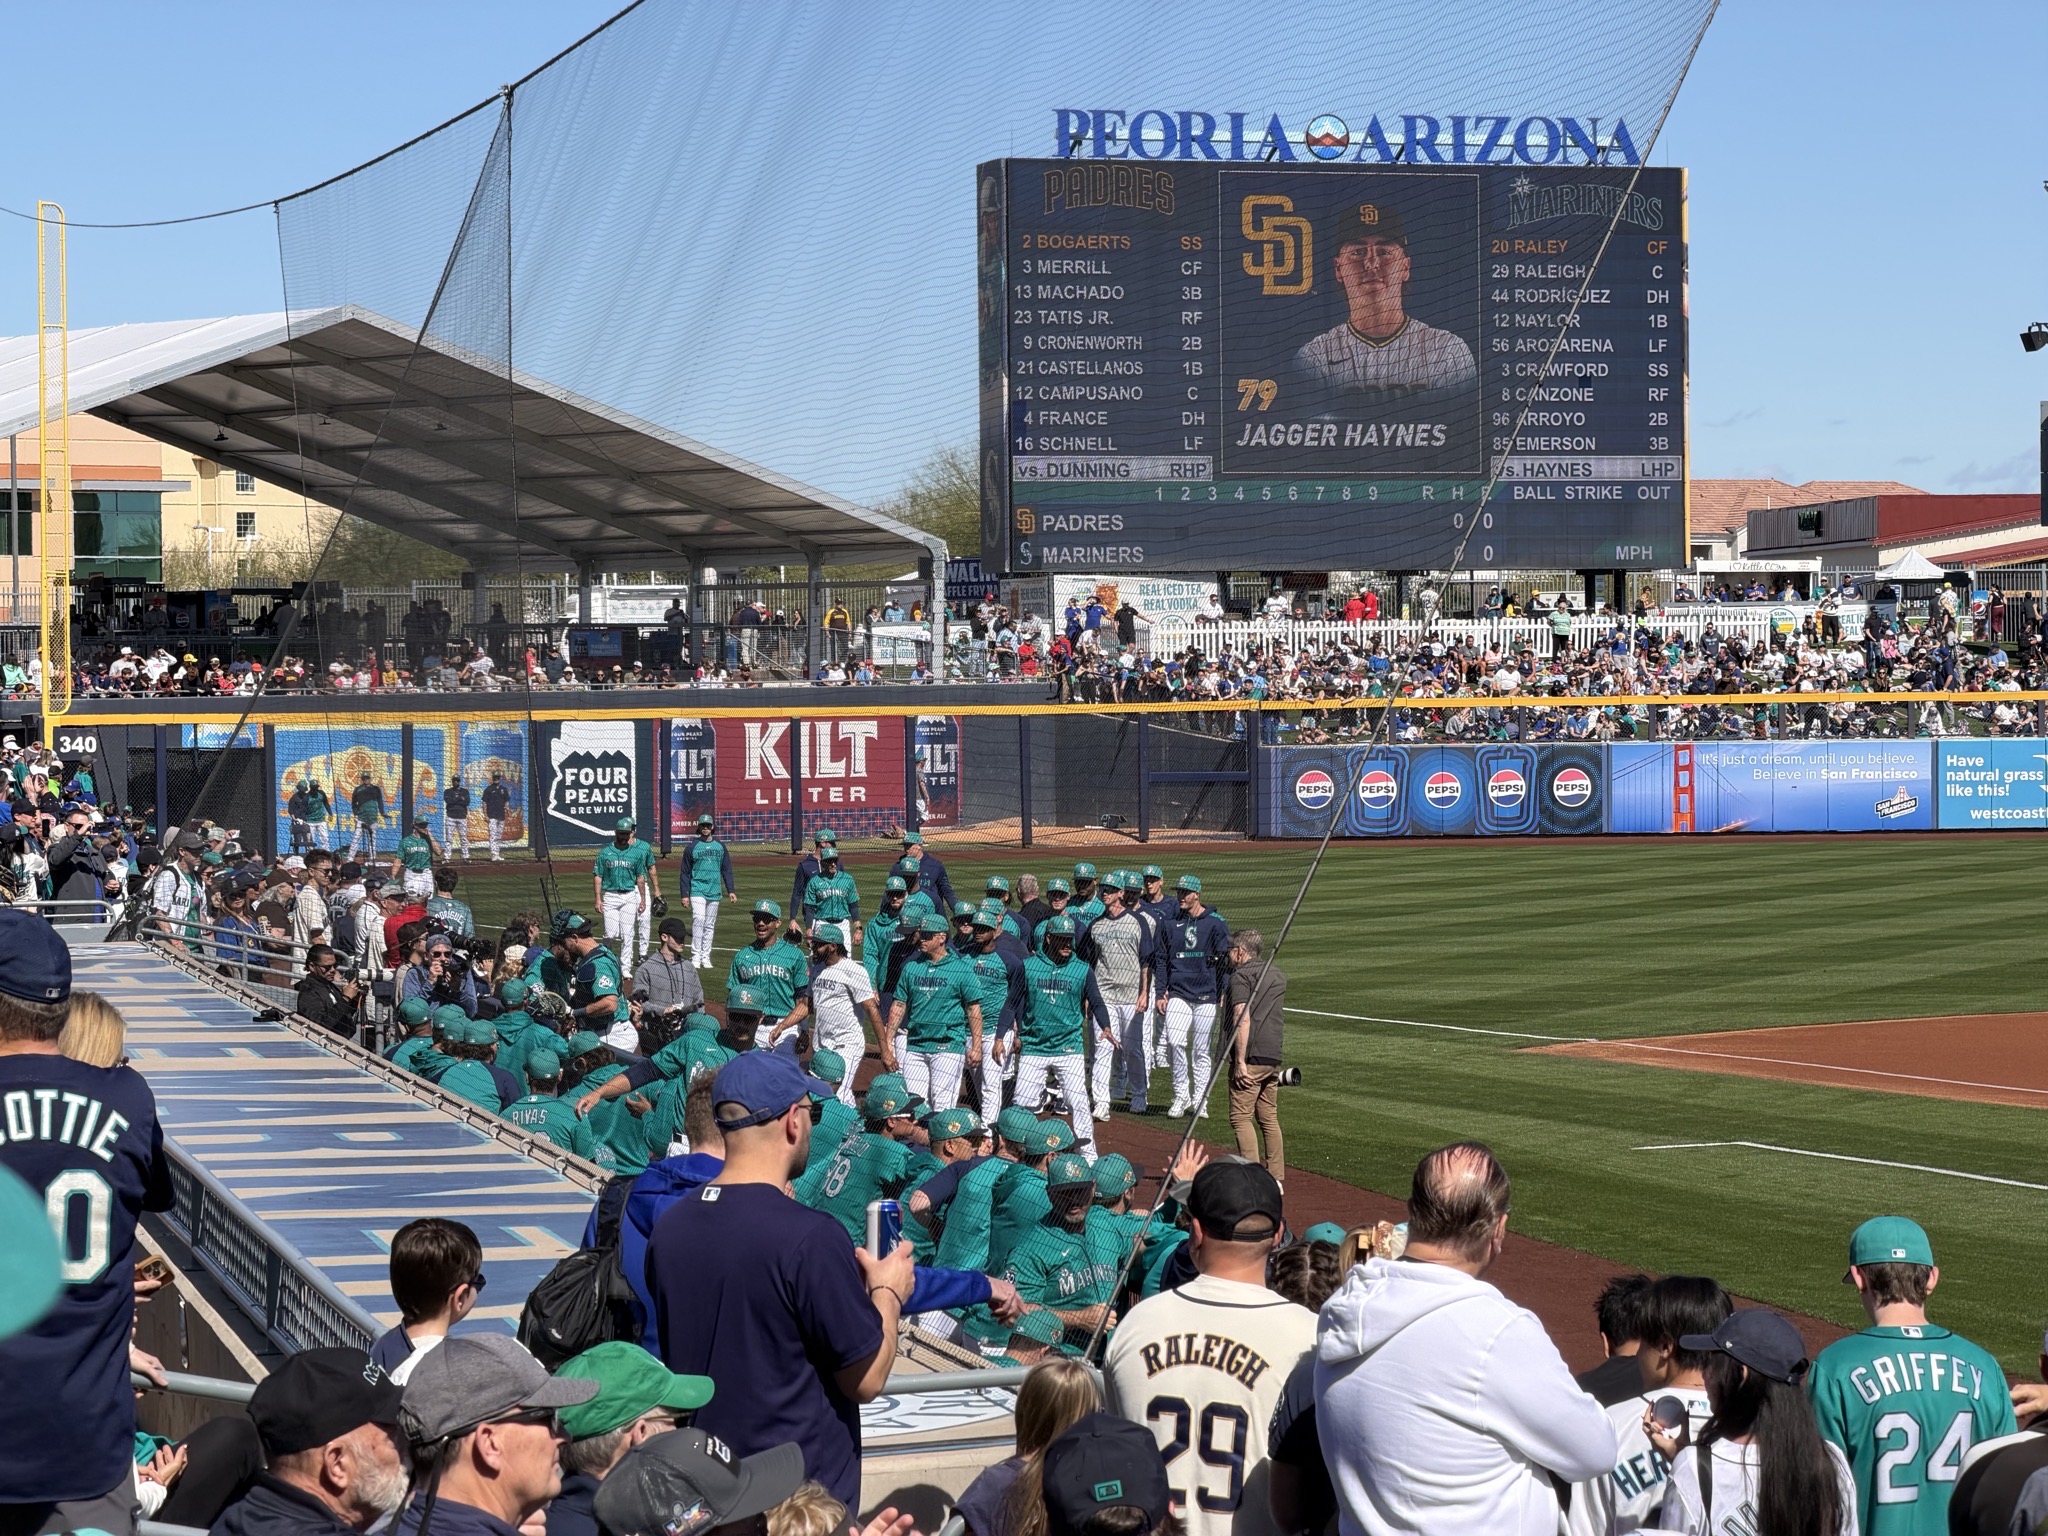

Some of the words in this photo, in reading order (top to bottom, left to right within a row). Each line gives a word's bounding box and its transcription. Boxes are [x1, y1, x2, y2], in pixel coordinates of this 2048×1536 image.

[1052, 109, 1298, 161] PEORIA
[1353, 112, 1643, 166] ARIZONA
[1044, 165, 1175, 215] PADRES
[1507, 184, 1663, 230] MARINERS
[1022, 235, 1031, 248] 2
[1037, 236, 1131, 249] BOGAERTS
[1181, 236, 1202, 250] SS
[1492, 240, 1508, 253] 20
[1515, 241, 1568, 254] RALEY
[1648, 241, 1667, 254] CF
[1023, 260, 1032, 274] 3
[1037, 260, 1111, 274] MERRILL
[1181, 261, 1202, 275] CF
[1492, 265, 1509, 278] 29
[1515, 265, 1586, 278] RALEIGH
[1653, 266, 1663, 279] C
[1015, 286, 1032, 299] 13
[1038, 286, 1125, 299] MACHADO
[1182, 287, 1202, 300] 3B
[1491, 290, 1509, 302] 44
[1515, 287, 1610, 303] RODRÍGUEZ
[1647, 290, 1669, 303] DH
[1014, 311, 1032, 324] 23
[1038, 311, 1083, 324] TATIS
[1088, 311, 1114, 324] JR.
[1181, 312, 1202, 325] RF
[1493, 314, 1509, 327] 12
[1515, 314, 1580, 327] NAYLOR
[1648, 315, 1667, 328] 1B
[1023, 336, 1032, 350] 9
[1038, 336, 1142, 350] CRONENWORTH
[1182, 337, 1202, 350] 2B
[1492, 339, 1509, 351] 56
[1515, 339, 1614, 352] AROZARENA
[1649, 339, 1667, 352] LF
[1017, 361, 1033, 374] 21
[1038, 361, 1143, 375] CASTELLANOS
[1183, 362, 1203, 375] 1B
[1502, 364, 1510, 376] 3
[1515, 363, 1609, 376] CRAWFORD
[1648, 364, 1668, 376] SS
[1016, 386, 1034, 400] 12
[1039, 386, 1143, 400] CAMPUSANO
[1187, 387, 1198, 400] C
[1237, 379, 1277, 411] 79
[1502, 388, 1510, 401] 8
[1516, 388, 1594, 401] CANZONE
[1648, 388, 1669, 401] RF
[1024, 412, 1033, 425] 4
[1039, 412, 1108, 425] FRANCE
[1182, 412, 1205, 425] DH
[1493, 413, 1510, 425] 96
[1516, 412, 1585, 425] ARROYO
[1648, 413, 1668, 425] 2B
[1236, 423, 1337, 447] JAGGER
[1344, 423, 1447, 447] HAYNES
[1016, 437, 1034, 450] 16
[1039, 437, 1117, 451] SCHNELL
[1185, 437, 1203, 450] LF
[1493, 438, 1509, 450] 85
[1516, 437, 1596, 450] EMERSON
[1649, 438, 1669, 450] 3B
[1018, 466, 1043, 477] vs.
[1047, 463, 1130, 478] DUNNING
[1171, 463, 1207, 477] RHP
[1523, 463, 1592, 477] HAYNES
[1641, 463, 1675, 477] LHP
[1156, 487, 1162, 500] 1
[1182, 487, 1190, 500] 2
[1208, 487, 1217, 500] 3
[1235, 487, 1244, 500] 4
[1262, 487, 1271, 500] 5
[1288, 487, 1298, 500] 6
[1315, 486, 1325, 500] 7
[1342, 486, 1351, 500] 8
[1368, 486, 1378, 500] 9
[1422, 486, 1434, 499] R
[1452, 487, 1463, 500] H
[1514, 487, 1555, 499] BALL
[1564, 487, 1622, 499] STRIKE
[1637, 487, 1671, 499] OUT
[1043, 515, 1123, 531] PADRES
[1453, 513, 1464, 529] 0
[1483, 513, 1493, 529] 0
[1043, 547, 1144, 563] MARINERS
[1483, 546, 1494, 562] 0
[1616, 546, 1652, 560] MPH
[1742, 562, 1763, 571] Kettle
[1139, 584, 1163, 596] REAL
[1164, 584, 1183, 595] ICED
[1144, 599, 1167, 611] REAL
[59, 736, 97, 753] 340
[1702, 754, 1718, 764] It's
[1722, 754, 1745, 767] just
[1749, 756, 1756, 764] a
[1759, 754, 1805, 767] dream,
[1809, 754, 1836, 764] until
[1840, 757, 1864, 767] you
[1868, 754, 1917, 764] believe.
[1946, 754, 1984, 767] Have
[565, 767, 627, 786] FOUR
[1754, 769, 1801, 779] Believe
[1806, 769, 1817, 779] in
[1821, 769, 1847, 779] San
[1852, 768, 1918, 779] Francisco
[1946, 768, 1999, 781] natural
[2004, 770, 2044, 783] grass
[565, 787, 628, 804] PEAKS
[756, 786, 867, 804] LITER
[1299, 785, 1333, 795] PEPSI
[1361, 785, 1395, 795] PEPSI
[1427, 785, 1459, 795] PEPSI
[1490, 784, 1524, 793] PEPSI
[1555, 783, 1589, 792] PEPSI
[1946, 784, 1973, 796] like
[1977, 784, 2009, 796] this!
[570, 806, 624, 814] BREWING
[325, 811, 401, 831] WHAT
[740, 965, 790, 980] MARINERS
[913, 976, 947, 988] MARINERS
[1037, 978, 1072, 991] MARINERS
[512, 1109, 548, 1126] RIVAS
[1140, 1333, 1270, 1391] RALEIGH
[1850, 1352, 1984, 1405] GRIFFEY
[1147, 1396, 1250, 1514] 29
[1874, 1411, 1974, 1505] 24
[1611, 1448, 1670, 1500] HER
